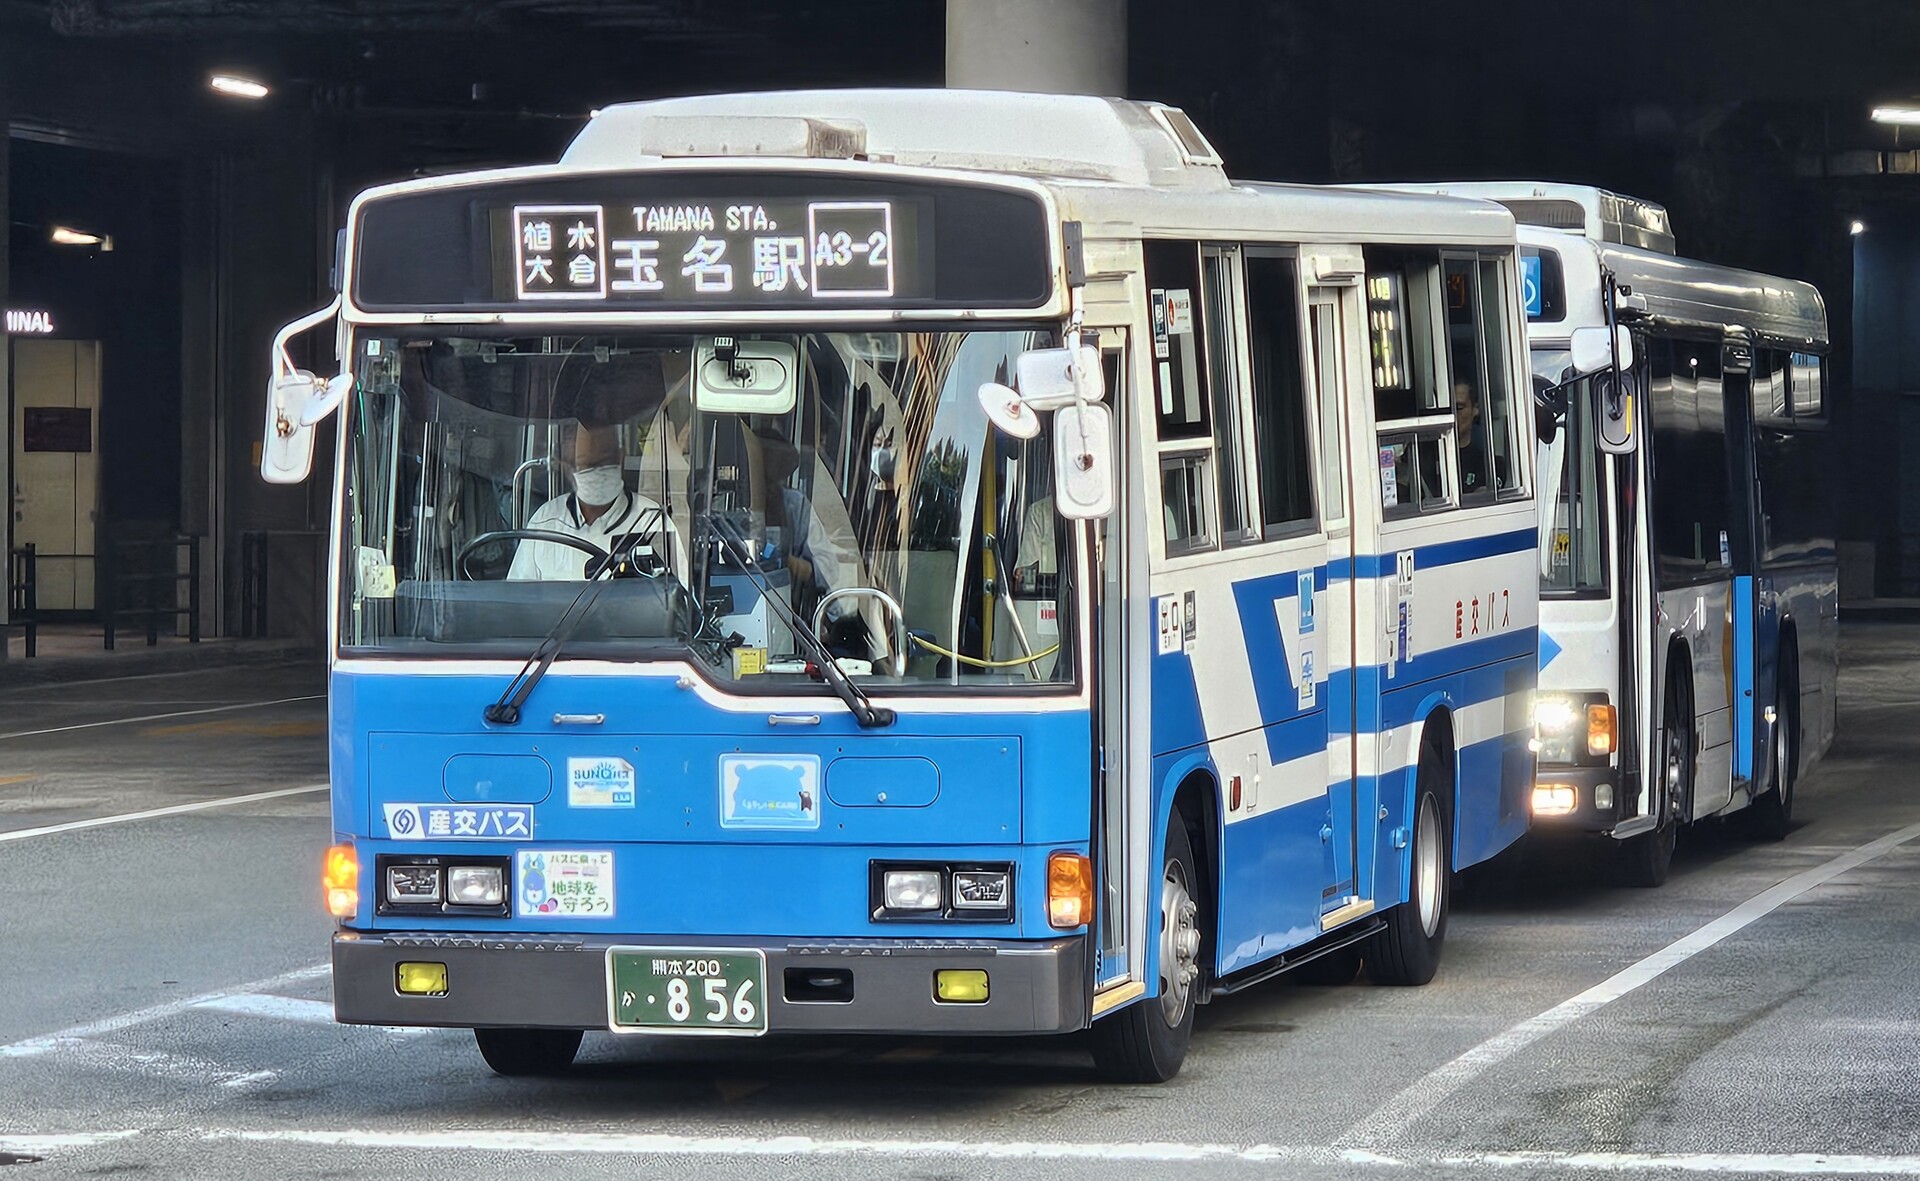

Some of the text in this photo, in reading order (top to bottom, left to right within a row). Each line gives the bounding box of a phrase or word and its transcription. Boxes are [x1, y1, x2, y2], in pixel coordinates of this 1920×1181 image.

[633, 205, 777, 232] TAMANA STA.
[523, 220, 596, 251] 植木
[815, 230, 888, 267] A3-2
[524, 253, 597, 285] 大倉
[611, 234, 809, 292] 玉名駅
[427, 809, 529, 836] 産交バス
[563, 896, 609, 913] 守ろう
